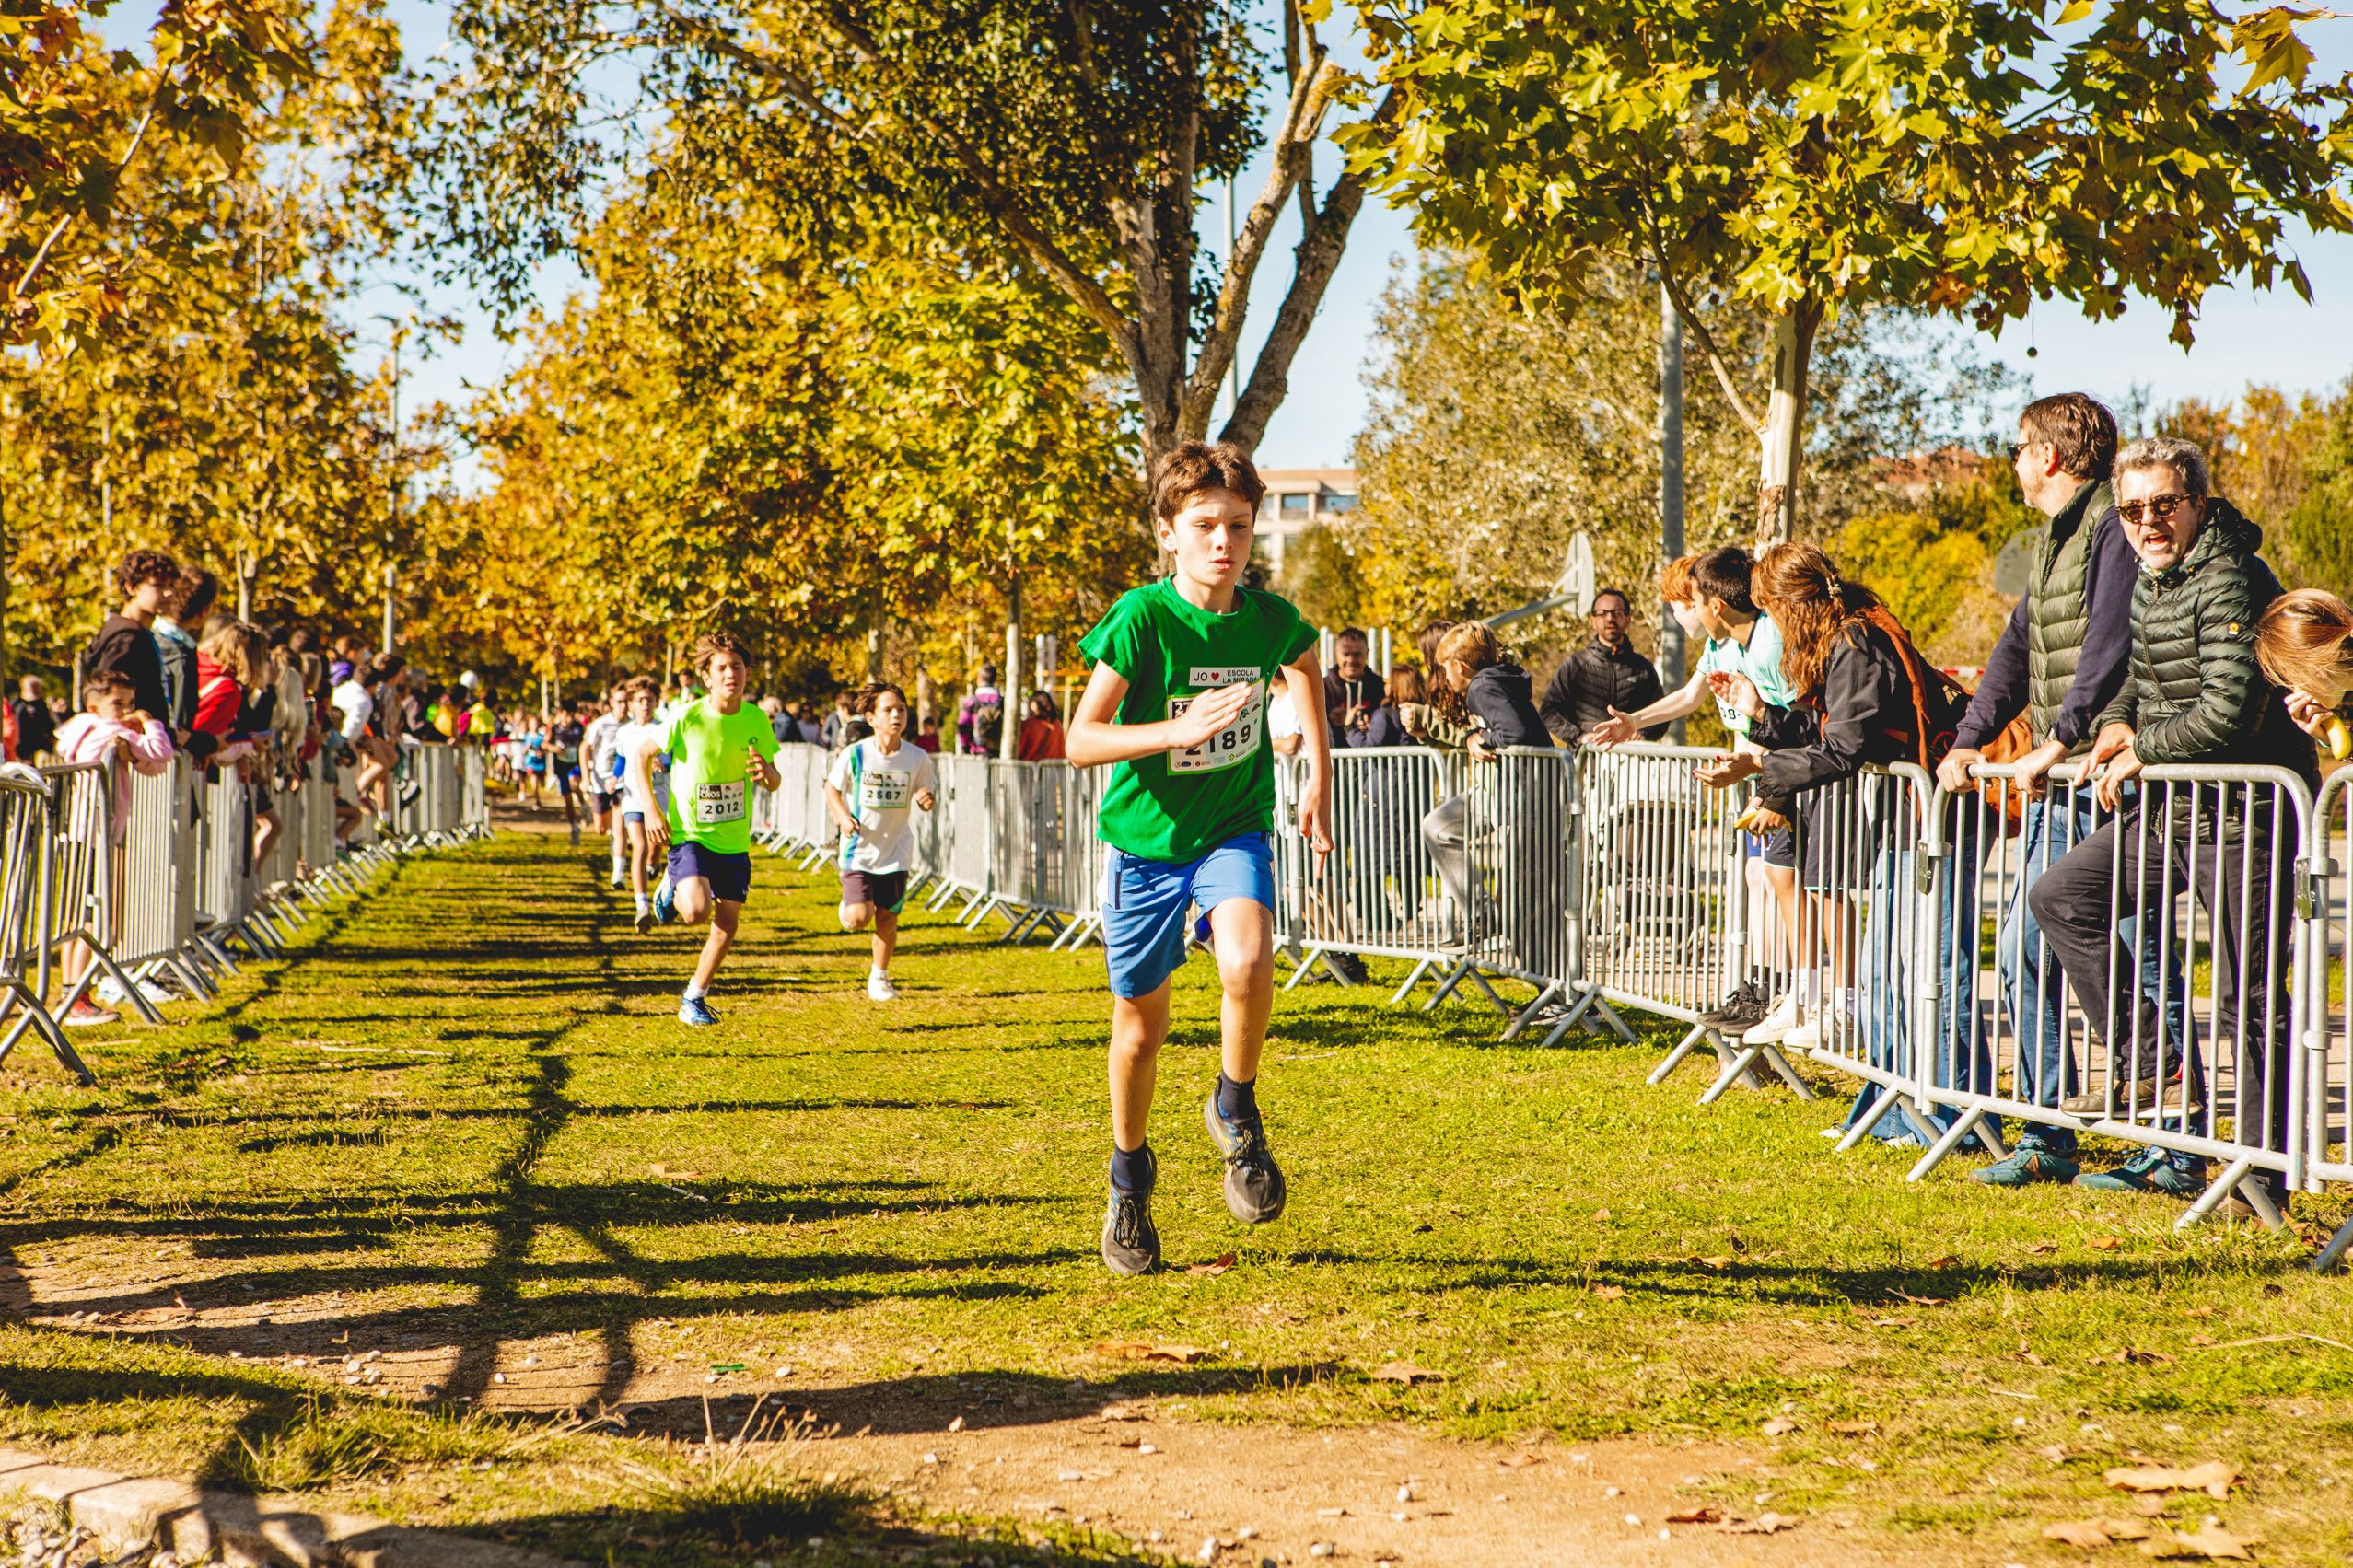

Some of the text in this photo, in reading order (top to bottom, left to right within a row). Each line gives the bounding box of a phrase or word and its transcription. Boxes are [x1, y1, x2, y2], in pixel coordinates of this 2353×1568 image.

[1194, 672, 1208, 681] JO
[867, 790, 901, 800] 2567
[705, 801, 739, 815] 2012
